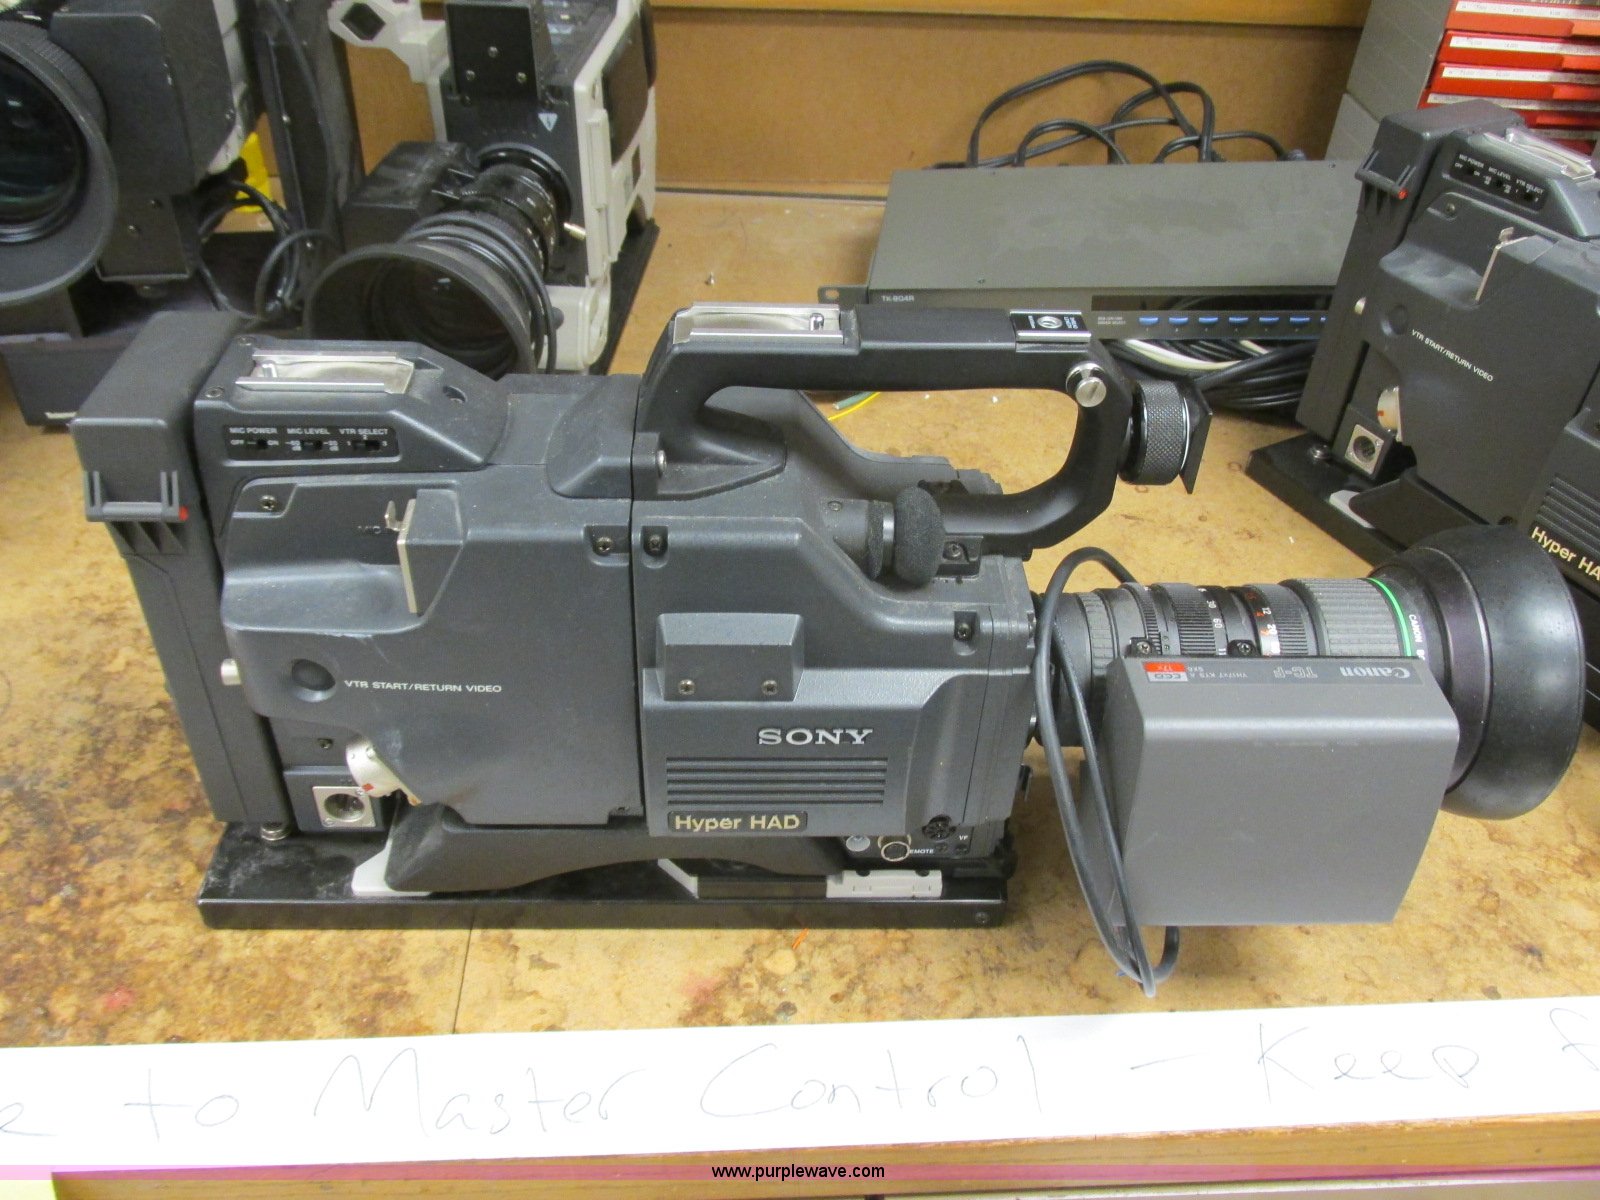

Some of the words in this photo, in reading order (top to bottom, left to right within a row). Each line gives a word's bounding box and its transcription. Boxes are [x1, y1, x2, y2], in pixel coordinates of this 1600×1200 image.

[1411, 329, 1425, 342] VTR
[1424, 337, 1473, 370] START/RETURN
[1473, 365, 1494, 382] VIDEO
[1531, 526, 1577, 563] Hyper
[1408, 614, 1423, 643] CANON
[1339, 665, 1411, 679] Canon
[344, 680, 369, 689] VTR
[372, 681, 462, 692] START/RETURN
[465, 684, 502, 693] VIDEO
[757, 727, 873, 746] SONY
[674, 814, 742, 832] Hyper
[749, 814, 801, 830] HAD
[123, 1068, 241, 1142] to
[312, 1047, 646, 1138] Master
[699, 1034, 1043, 1118] Control
[1257, 1021, 1480, 1106] Keep
